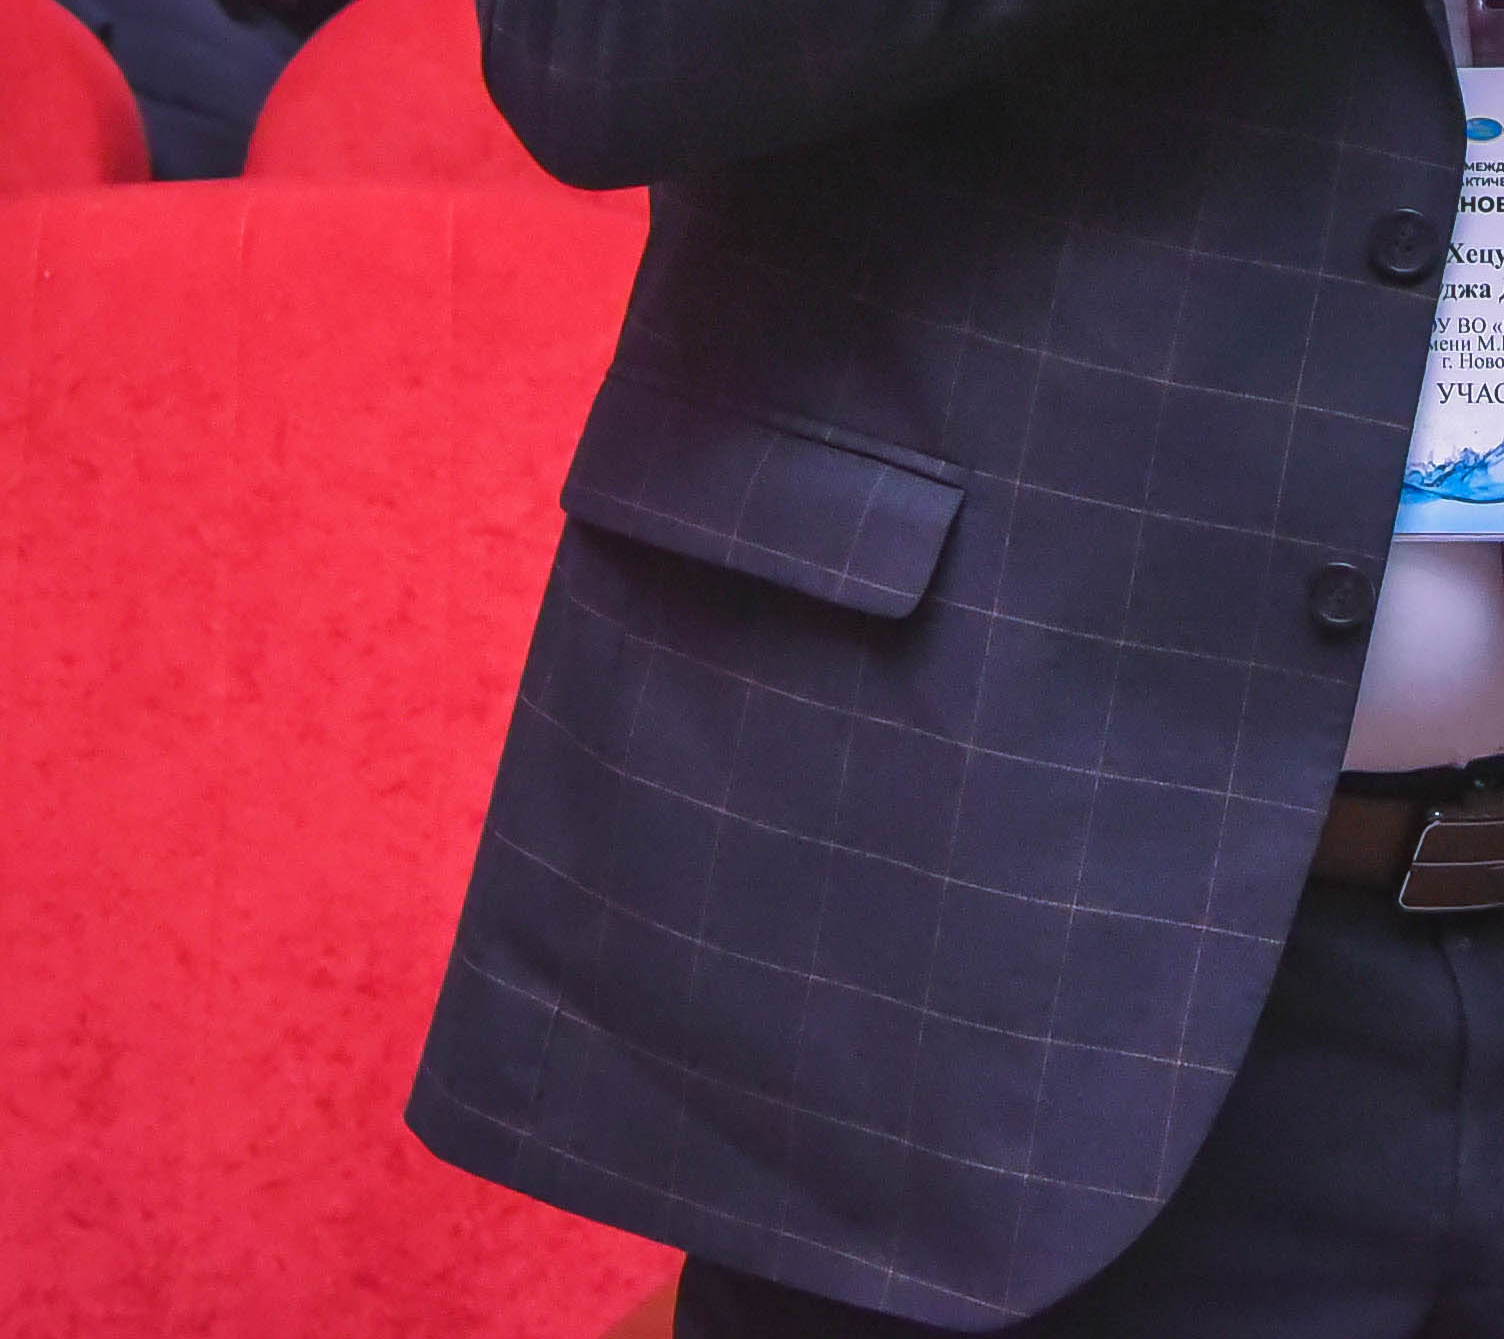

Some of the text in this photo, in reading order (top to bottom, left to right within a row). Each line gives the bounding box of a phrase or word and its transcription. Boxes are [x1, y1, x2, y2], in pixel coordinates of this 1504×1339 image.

[1441, 283, 1492, 300] джа
[1458, 317, 1487, 334] ВО
[1442, 358, 1453, 369] г.
